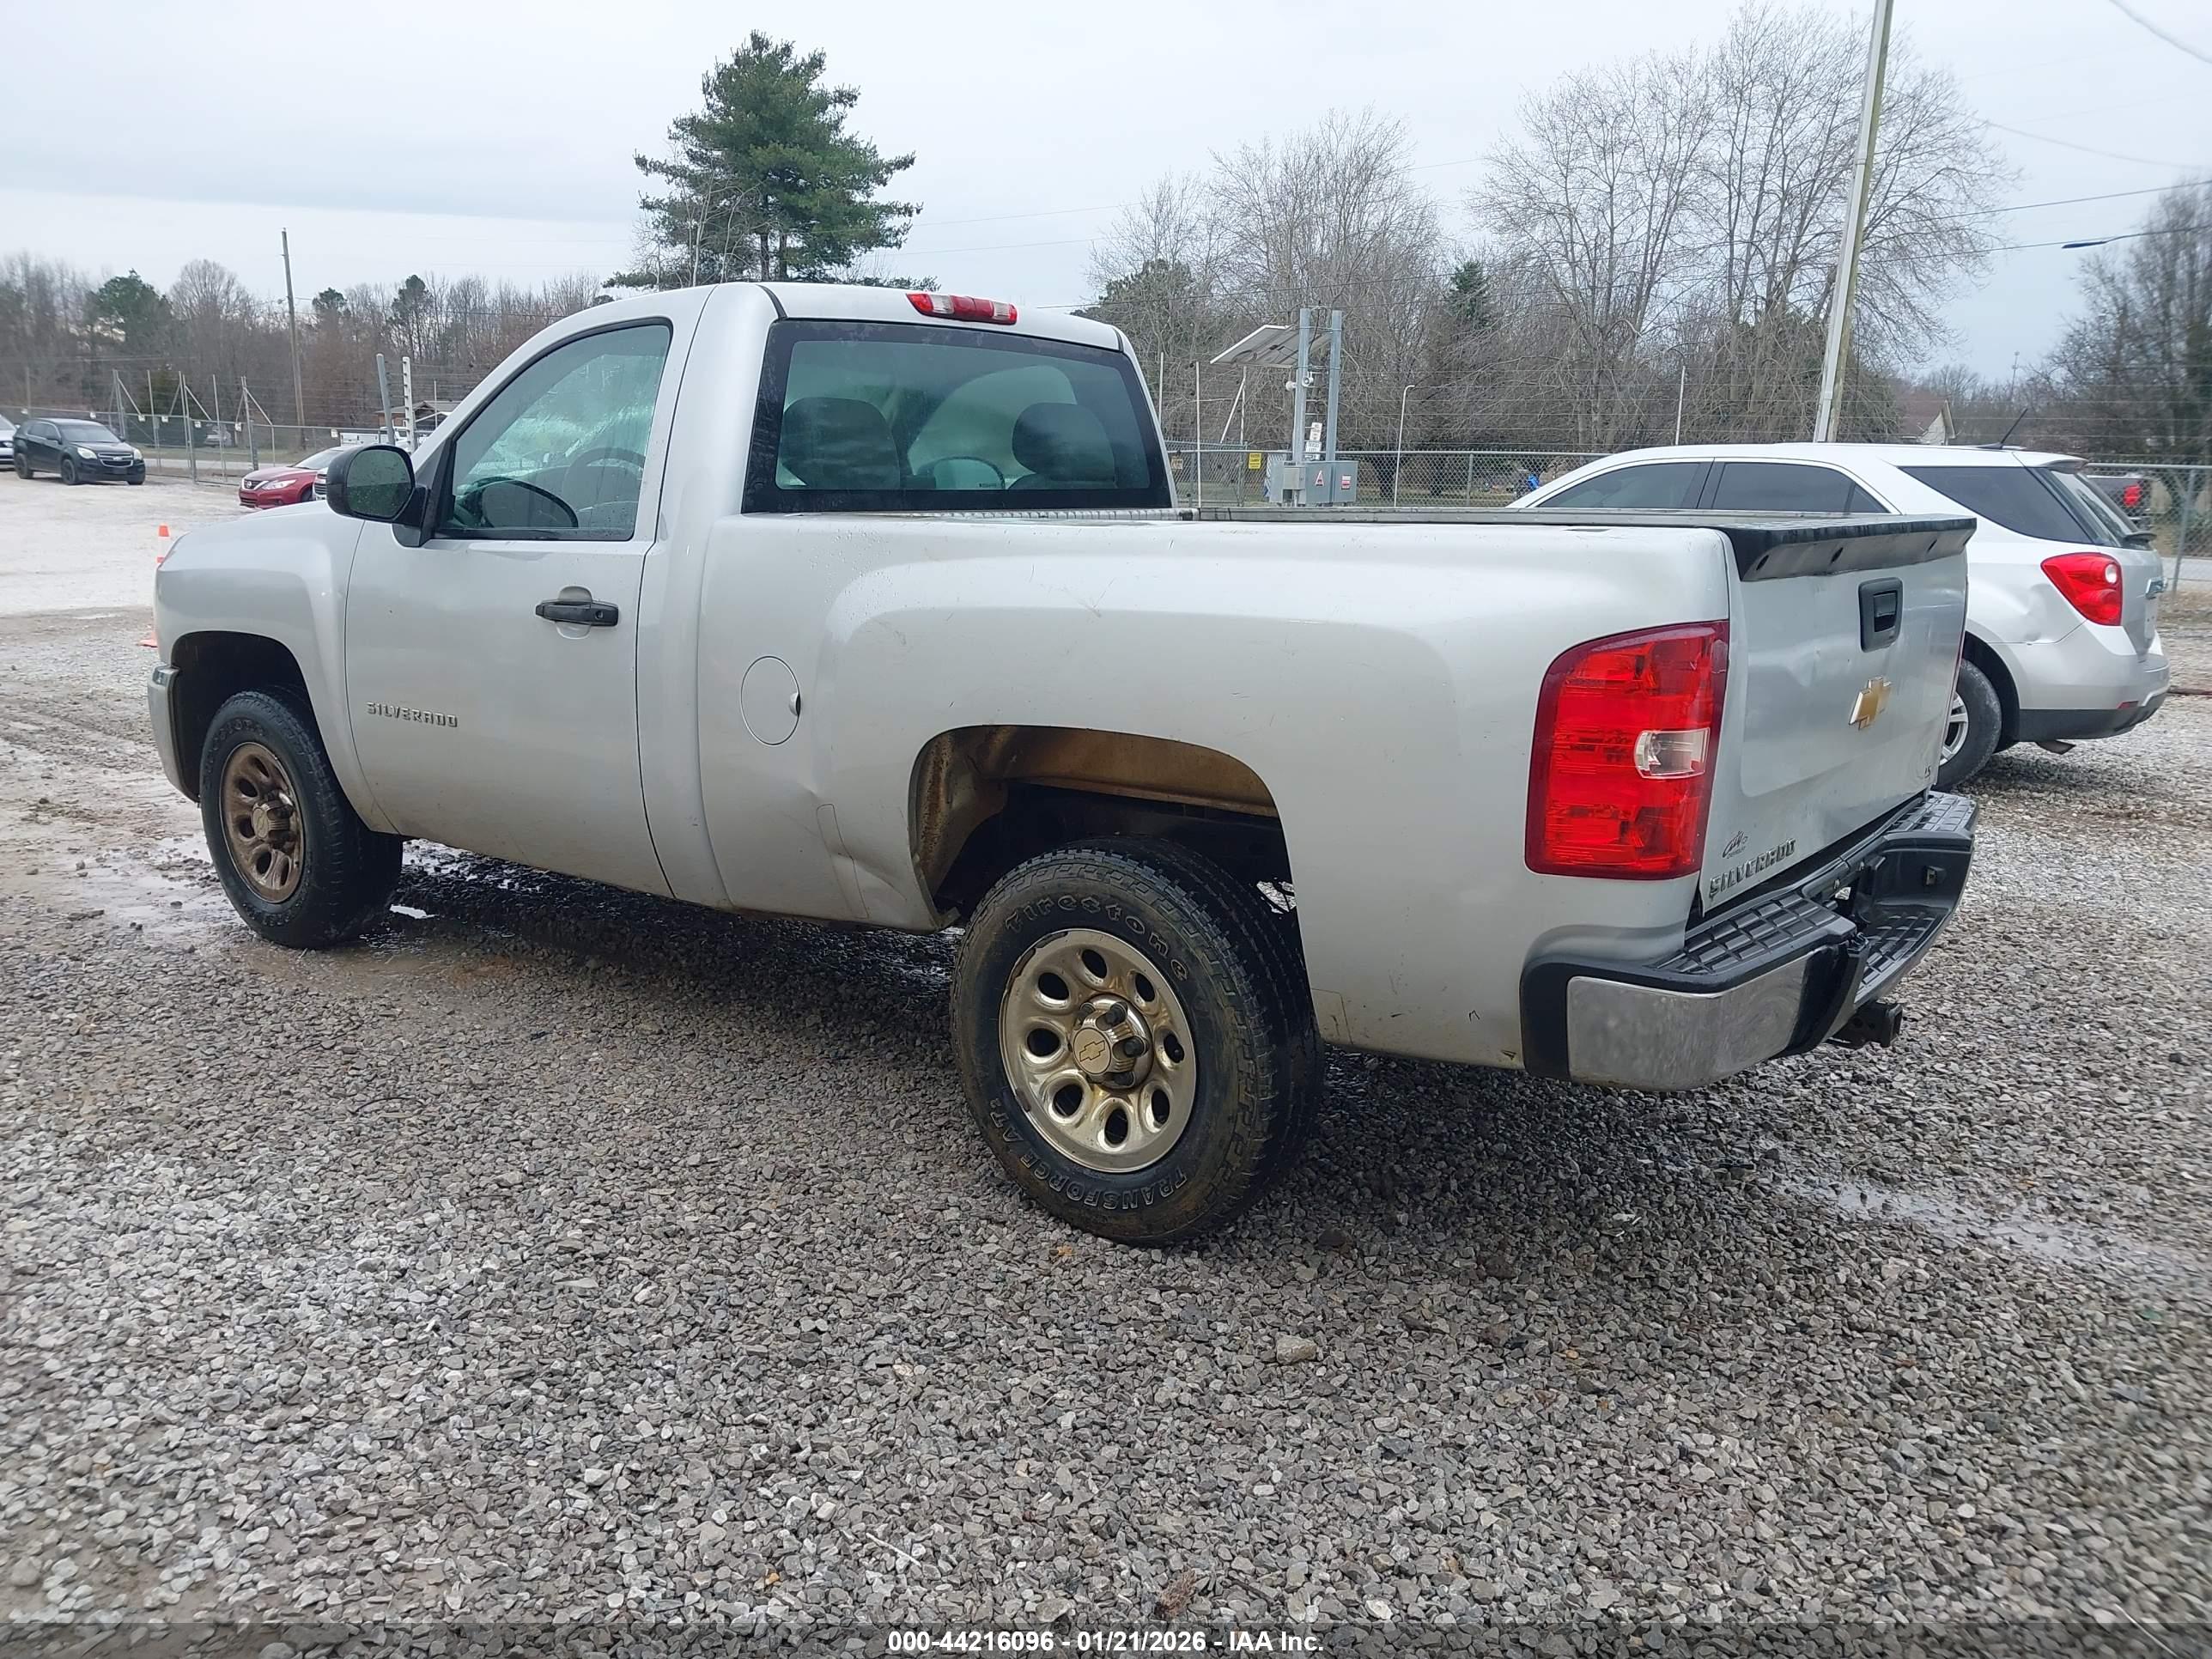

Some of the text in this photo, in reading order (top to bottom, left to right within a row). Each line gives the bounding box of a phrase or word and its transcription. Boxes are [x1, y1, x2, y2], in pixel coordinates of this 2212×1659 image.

[367, 701, 459, 728] SILVERADO
[1709, 838, 1796, 896] SILVERADO
[1019, 1149, 1188, 1210] TRANSFORCE
